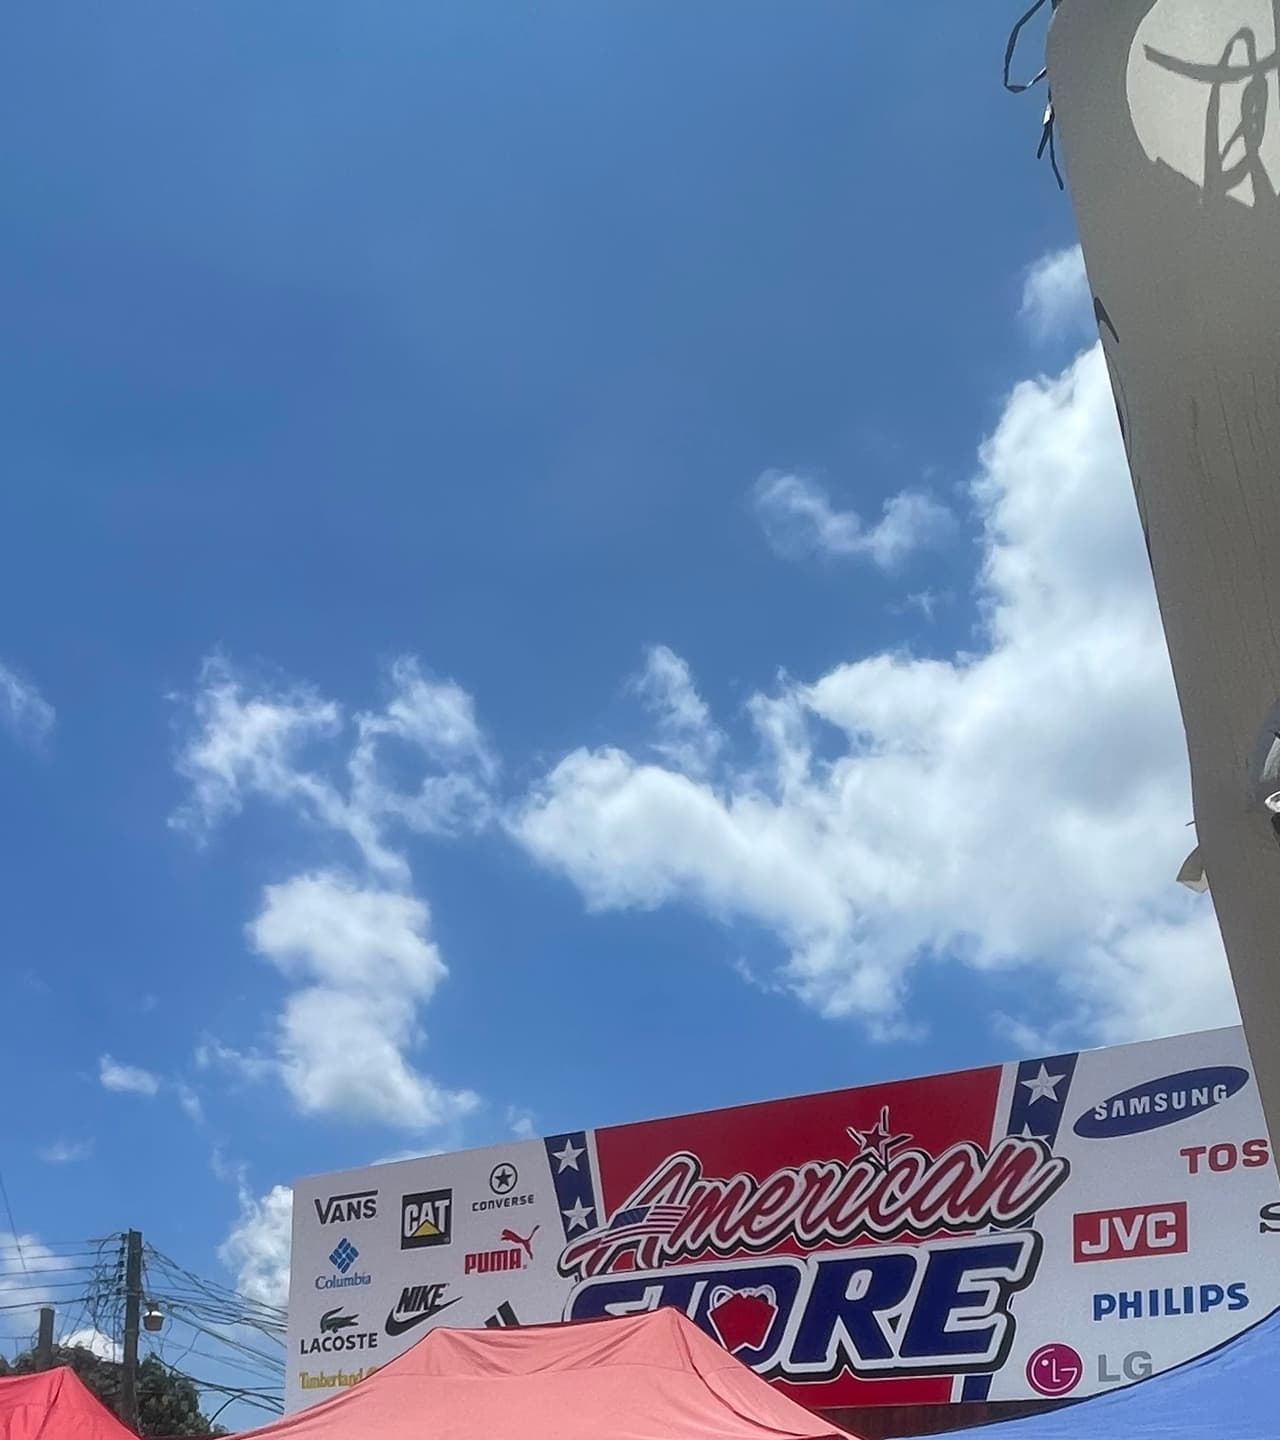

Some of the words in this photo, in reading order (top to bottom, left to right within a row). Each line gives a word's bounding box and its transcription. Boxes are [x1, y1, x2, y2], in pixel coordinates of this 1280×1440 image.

[1094, 1083, 1228, 1121] SAMSUNG
[314, 1190, 378, 1225] VANS
[404, 1199, 451, 1238] CAT
[472, 1194, 535, 1212] CONVERSE
[558, 1136, 1070, 1278] American
[1080, 1211, 1177, 1255] JVC
[464, 1248, 522, 1275] PUMA
[315, 1272, 372, 1290] Columbia
[396, 1283, 447, 1313] NIKE
[1093, 1283, 1250, 1321] PHILIPS
[300, 1332, 378, 1355] LACOSTE
[1098, 1351, 1153, 1382] LG
